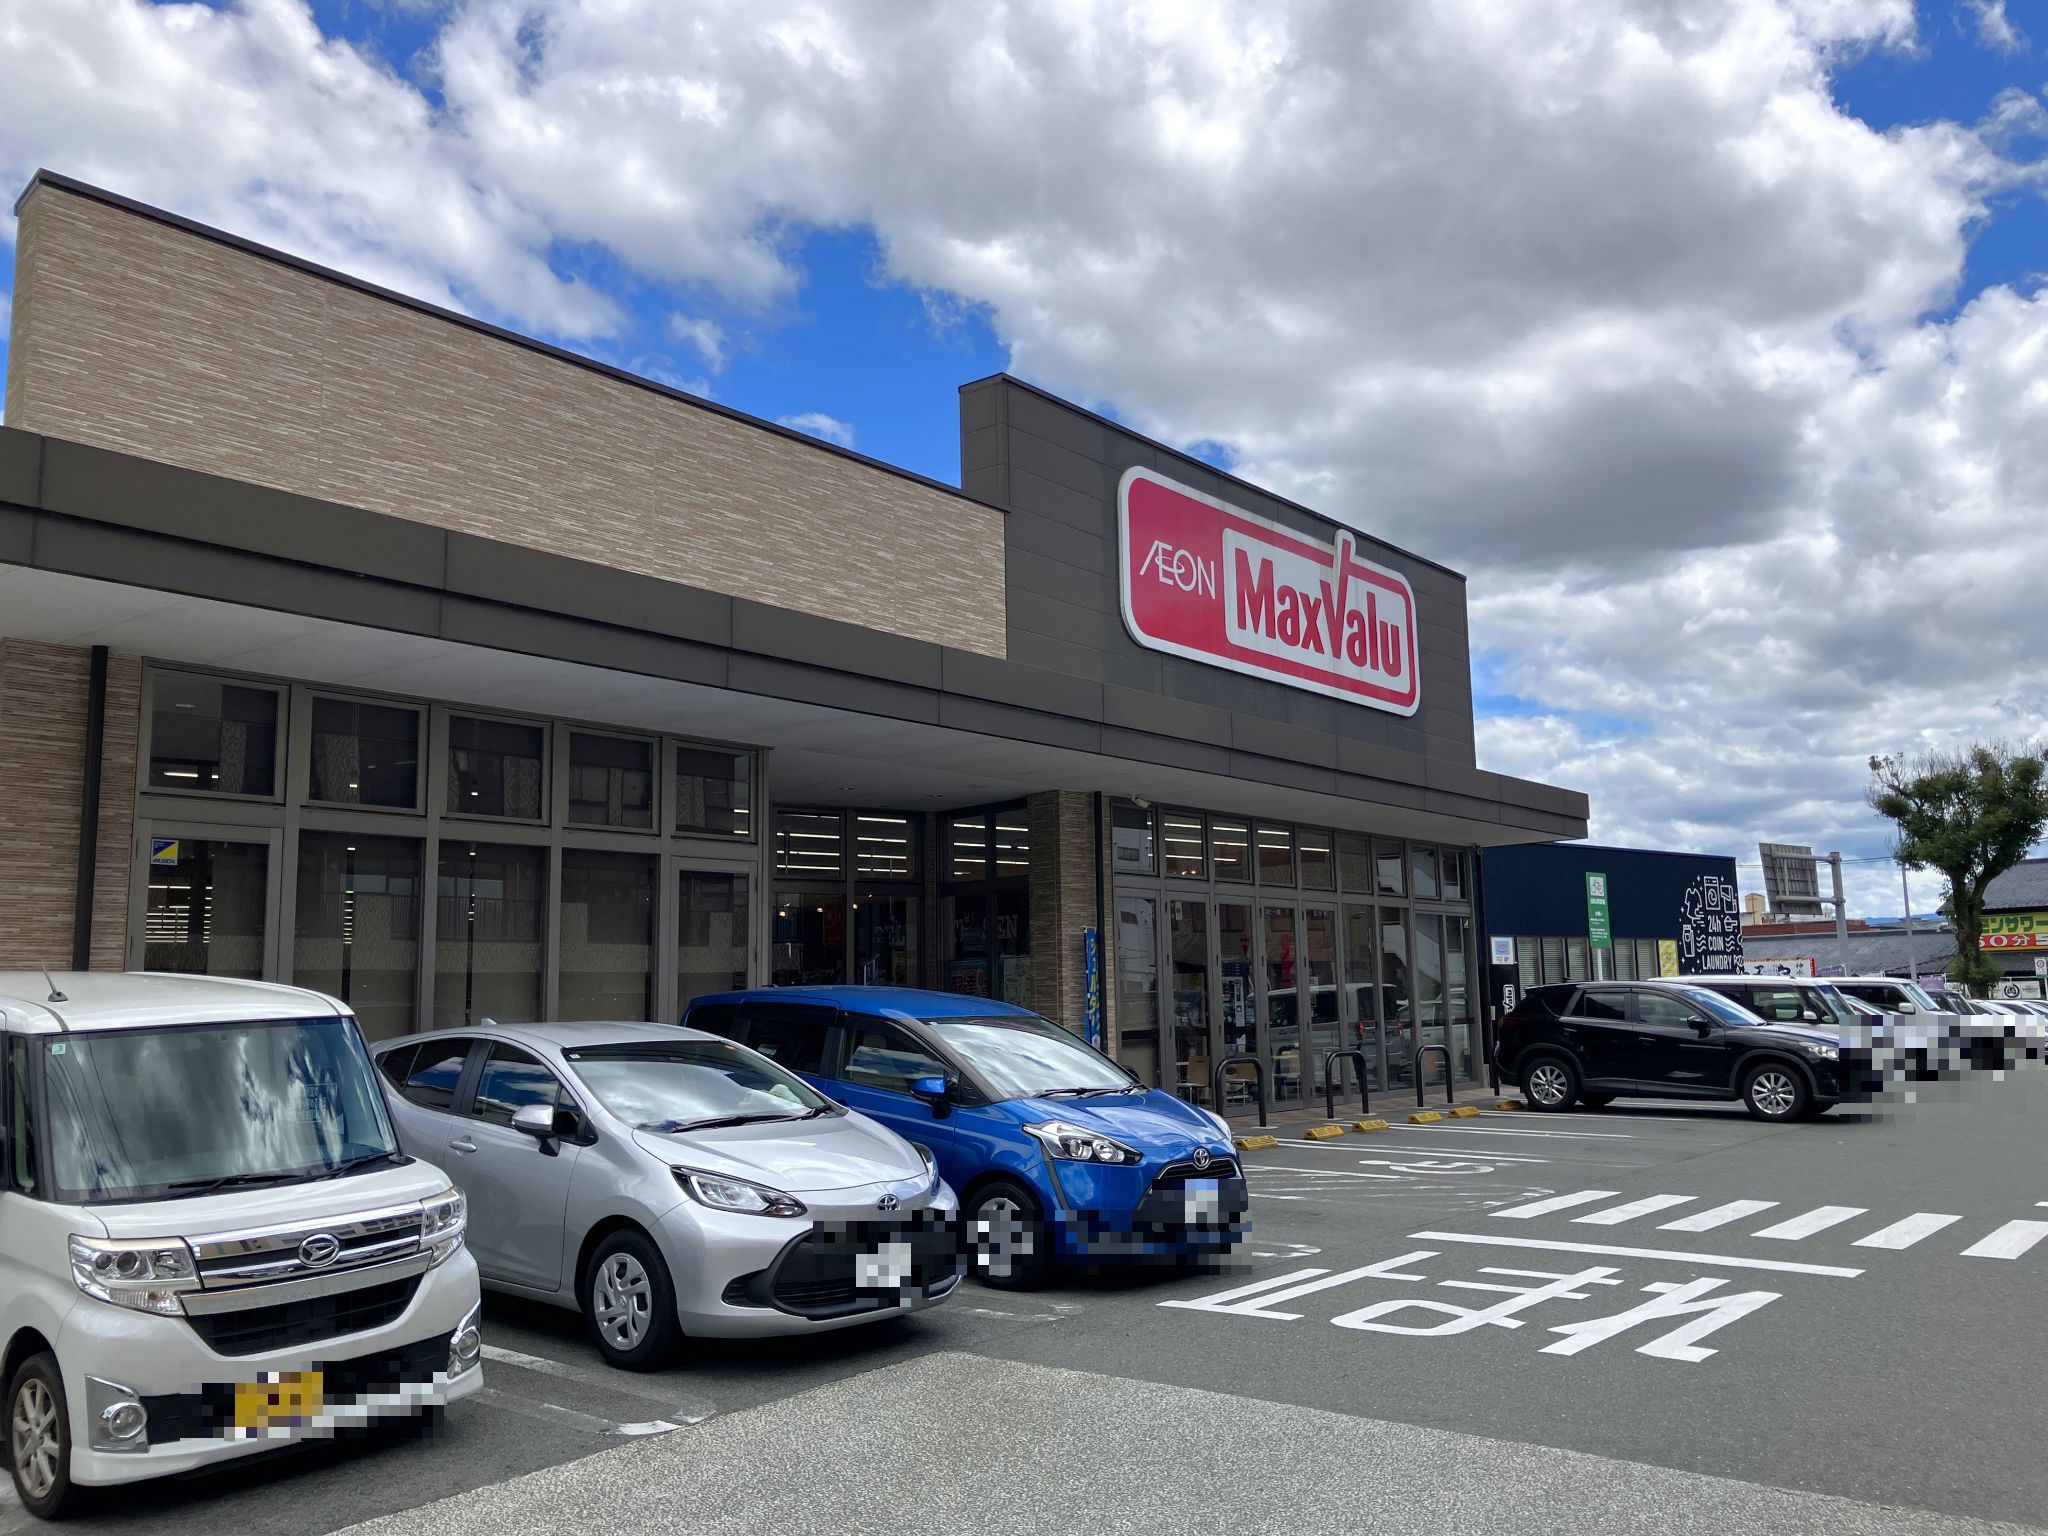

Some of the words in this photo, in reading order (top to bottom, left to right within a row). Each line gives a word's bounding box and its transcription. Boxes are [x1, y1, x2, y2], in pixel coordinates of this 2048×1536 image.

[1234, 538, 1402, 678] MaxValu
[1707, 915, 1722, 933] 24h
[1708, 936, 1724, 951] COIN
[1702, 954, 1732, 970] LAUNDRY
[1157, 1250, 1784, 1363] 止まれ
